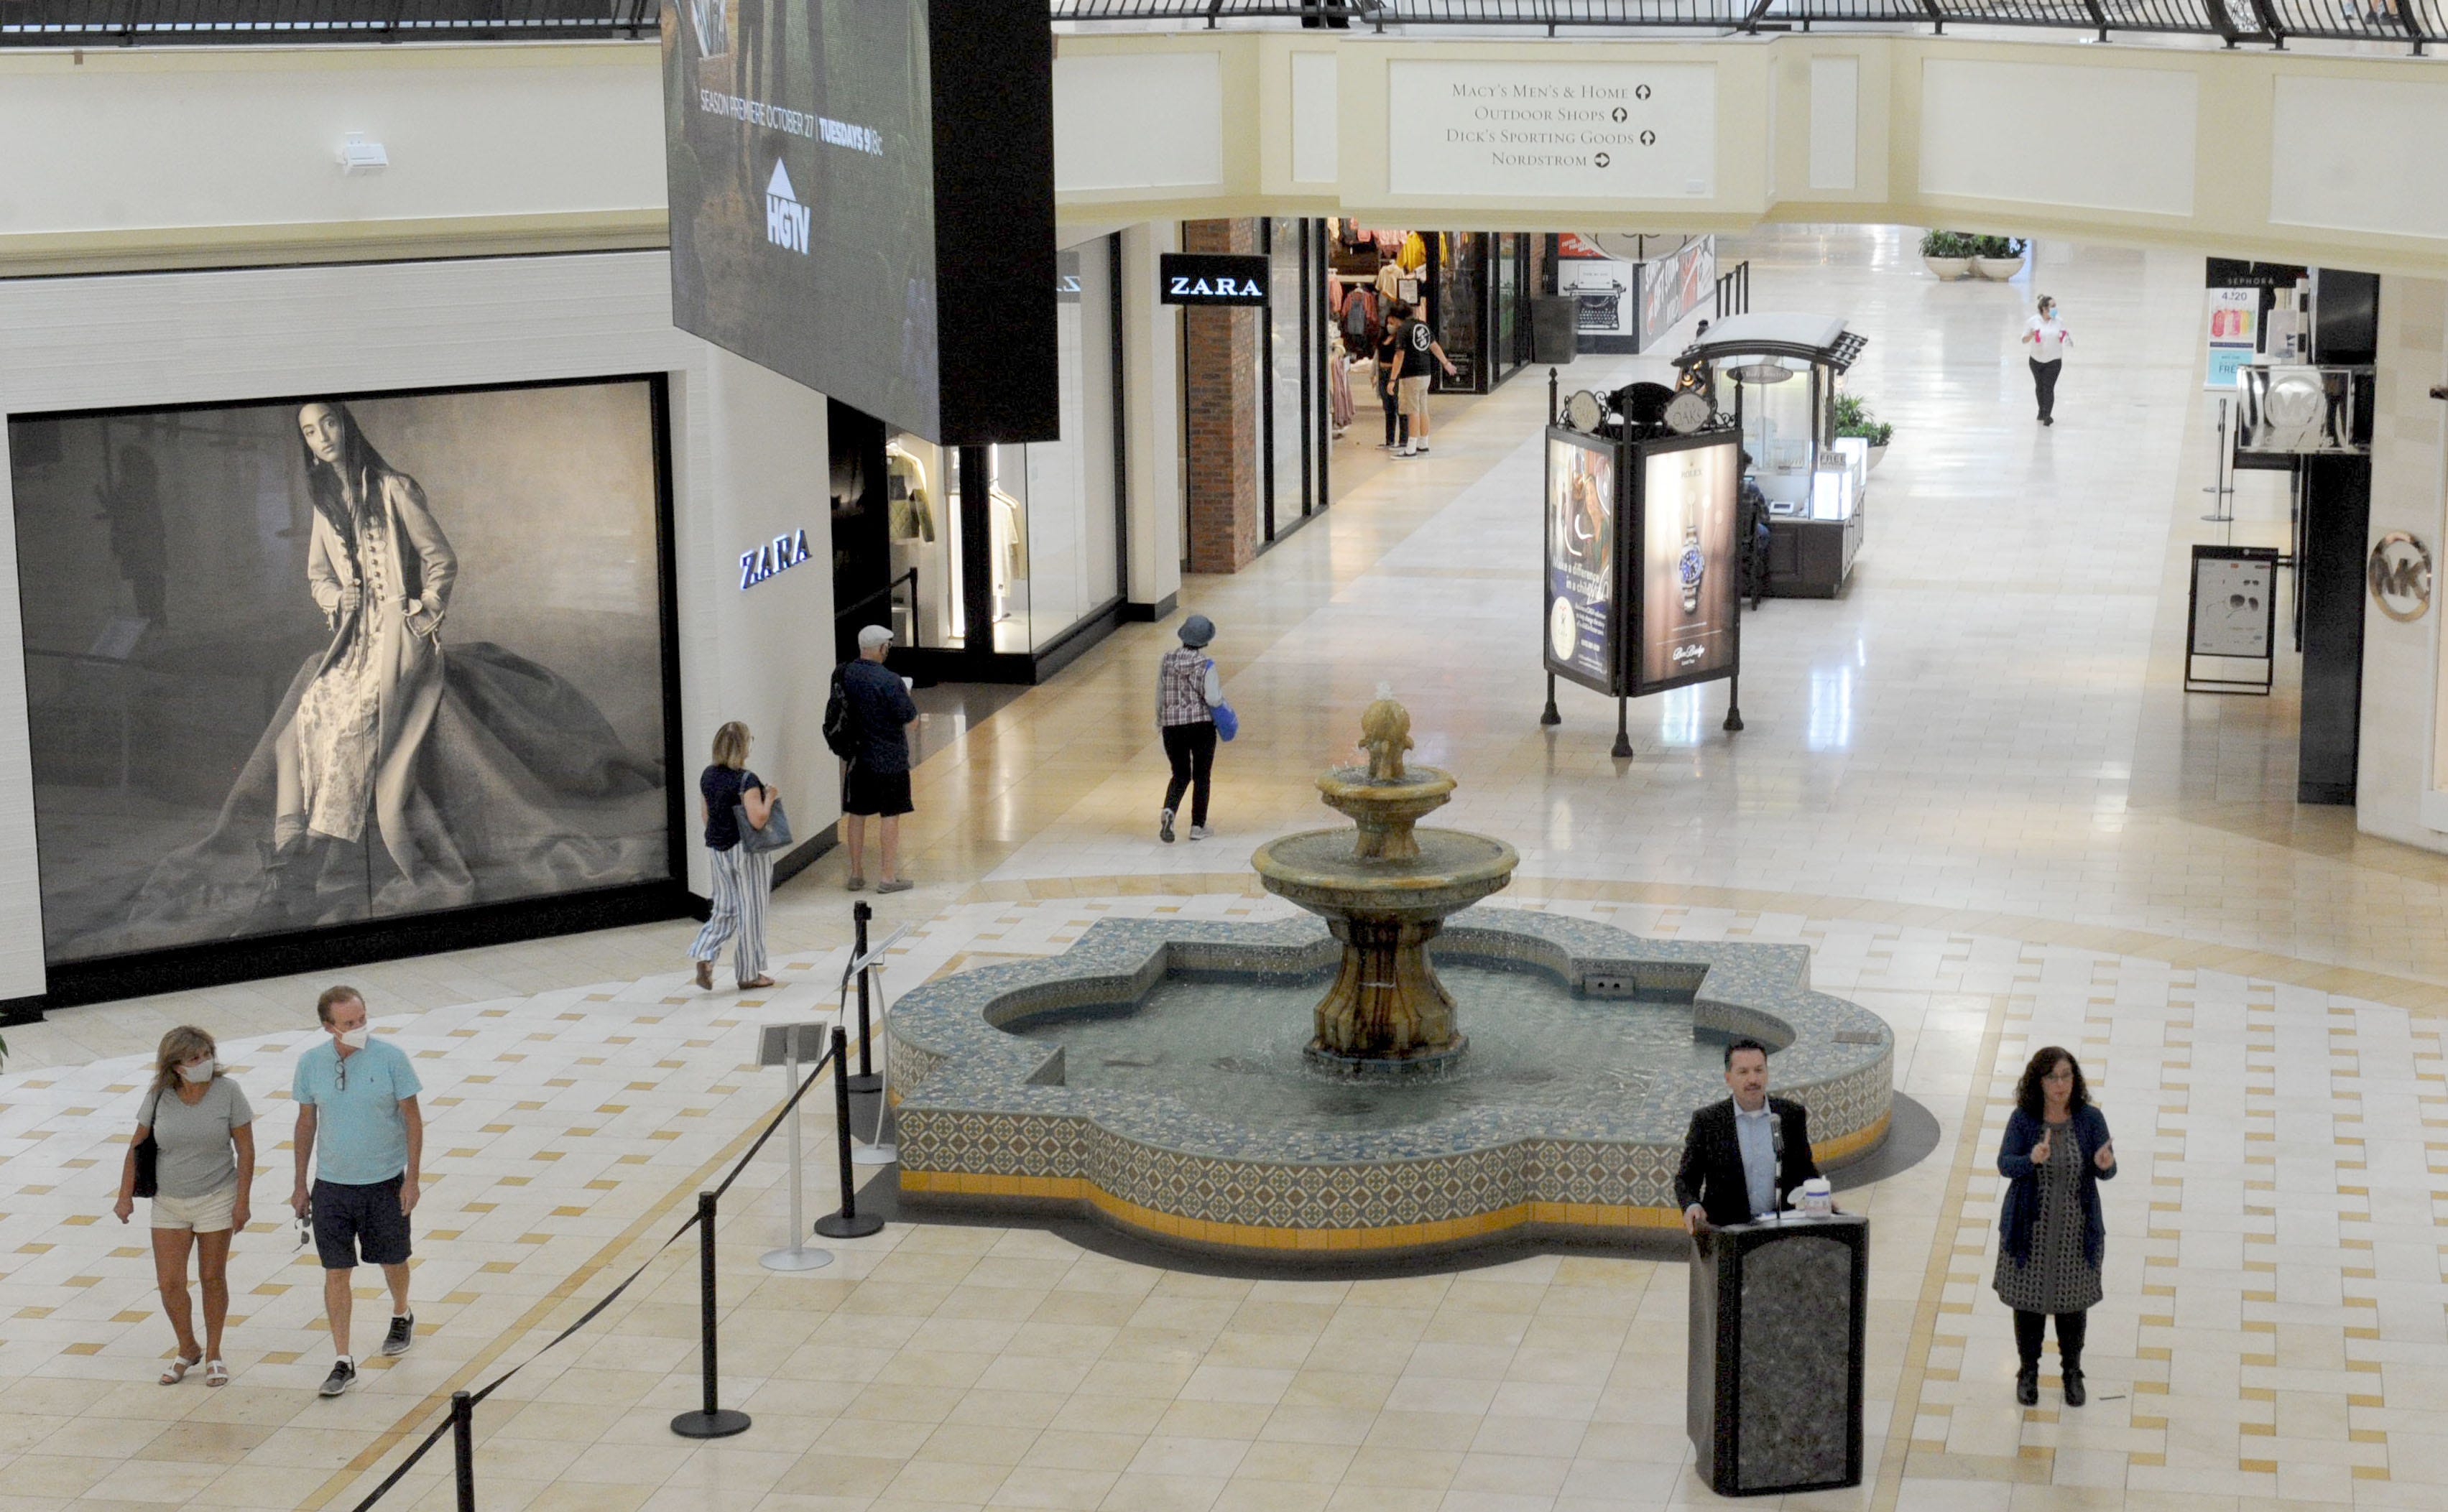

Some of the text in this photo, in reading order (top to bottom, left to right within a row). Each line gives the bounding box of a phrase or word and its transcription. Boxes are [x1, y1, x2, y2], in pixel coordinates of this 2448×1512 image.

[1563, 87, 1575, 99] &
[1581, 84, 1627, 99] HOME
[701, 88, 729, 117] SEASON
[729, 96, 765, 126] PREMIERE
[767, 105, 803, 136] OCTOBER
[804, 113, 813, 138] 27
[818, 117, 863, 151] TUESDAYS
[1474, 106, 1605, 121] OUTDOOR SHOPS
[1500, 129, 1576, 144] SPORTING
[1581, 130, 1635, 144] GOODS
[1492, 152, 1586, 167] NORDSTROM
[766, 193, 810, 256] HGTV
[1170, 277, 1262, 296] ZARA
[2219, 365, 2237, 374] FRE
[1673, 407, 1702, 427] OAKS
[1681, 469, 1703, 479] ROLEX
[739, 528, 813, 591] ZARA
[2373, 553, 2429, 600] MK
